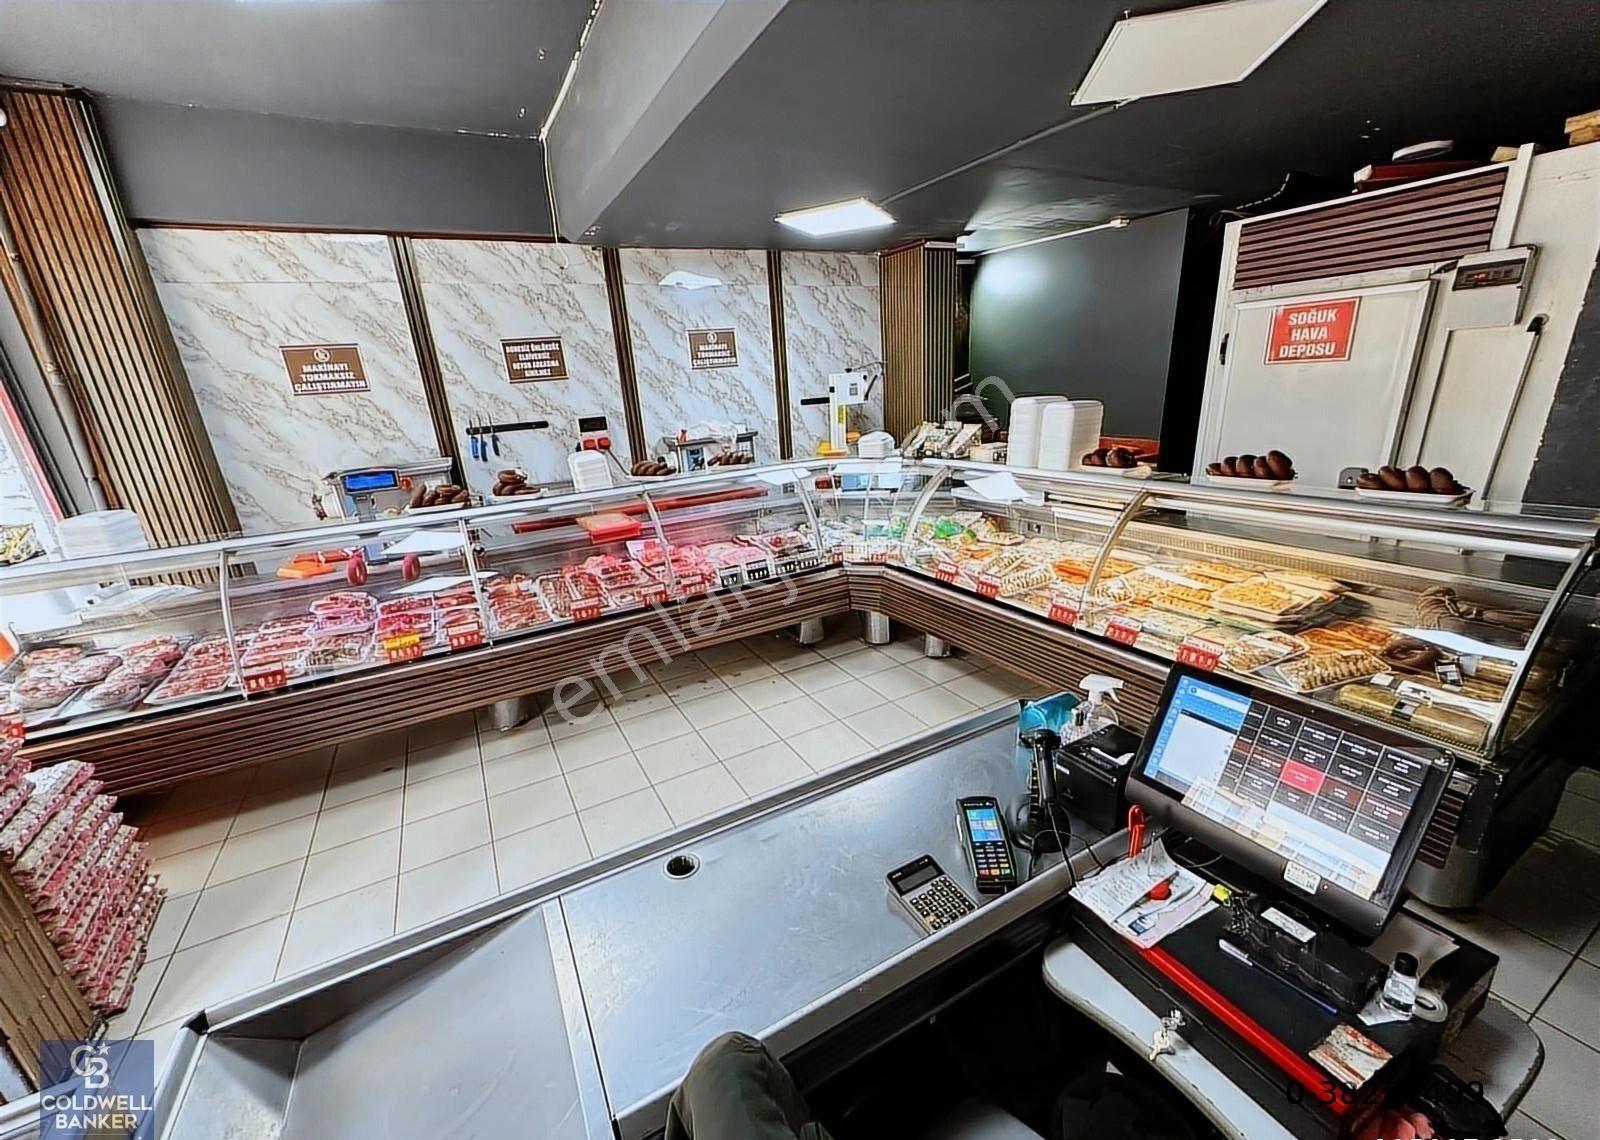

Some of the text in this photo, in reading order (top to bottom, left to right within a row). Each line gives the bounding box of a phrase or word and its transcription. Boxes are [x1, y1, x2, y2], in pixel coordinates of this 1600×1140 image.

[1288, 308, 1338, 325] SOĞUK
[1291, 327, 1328, 341] HAVA
[1279, 342, 1336, 358] DEPOSU
